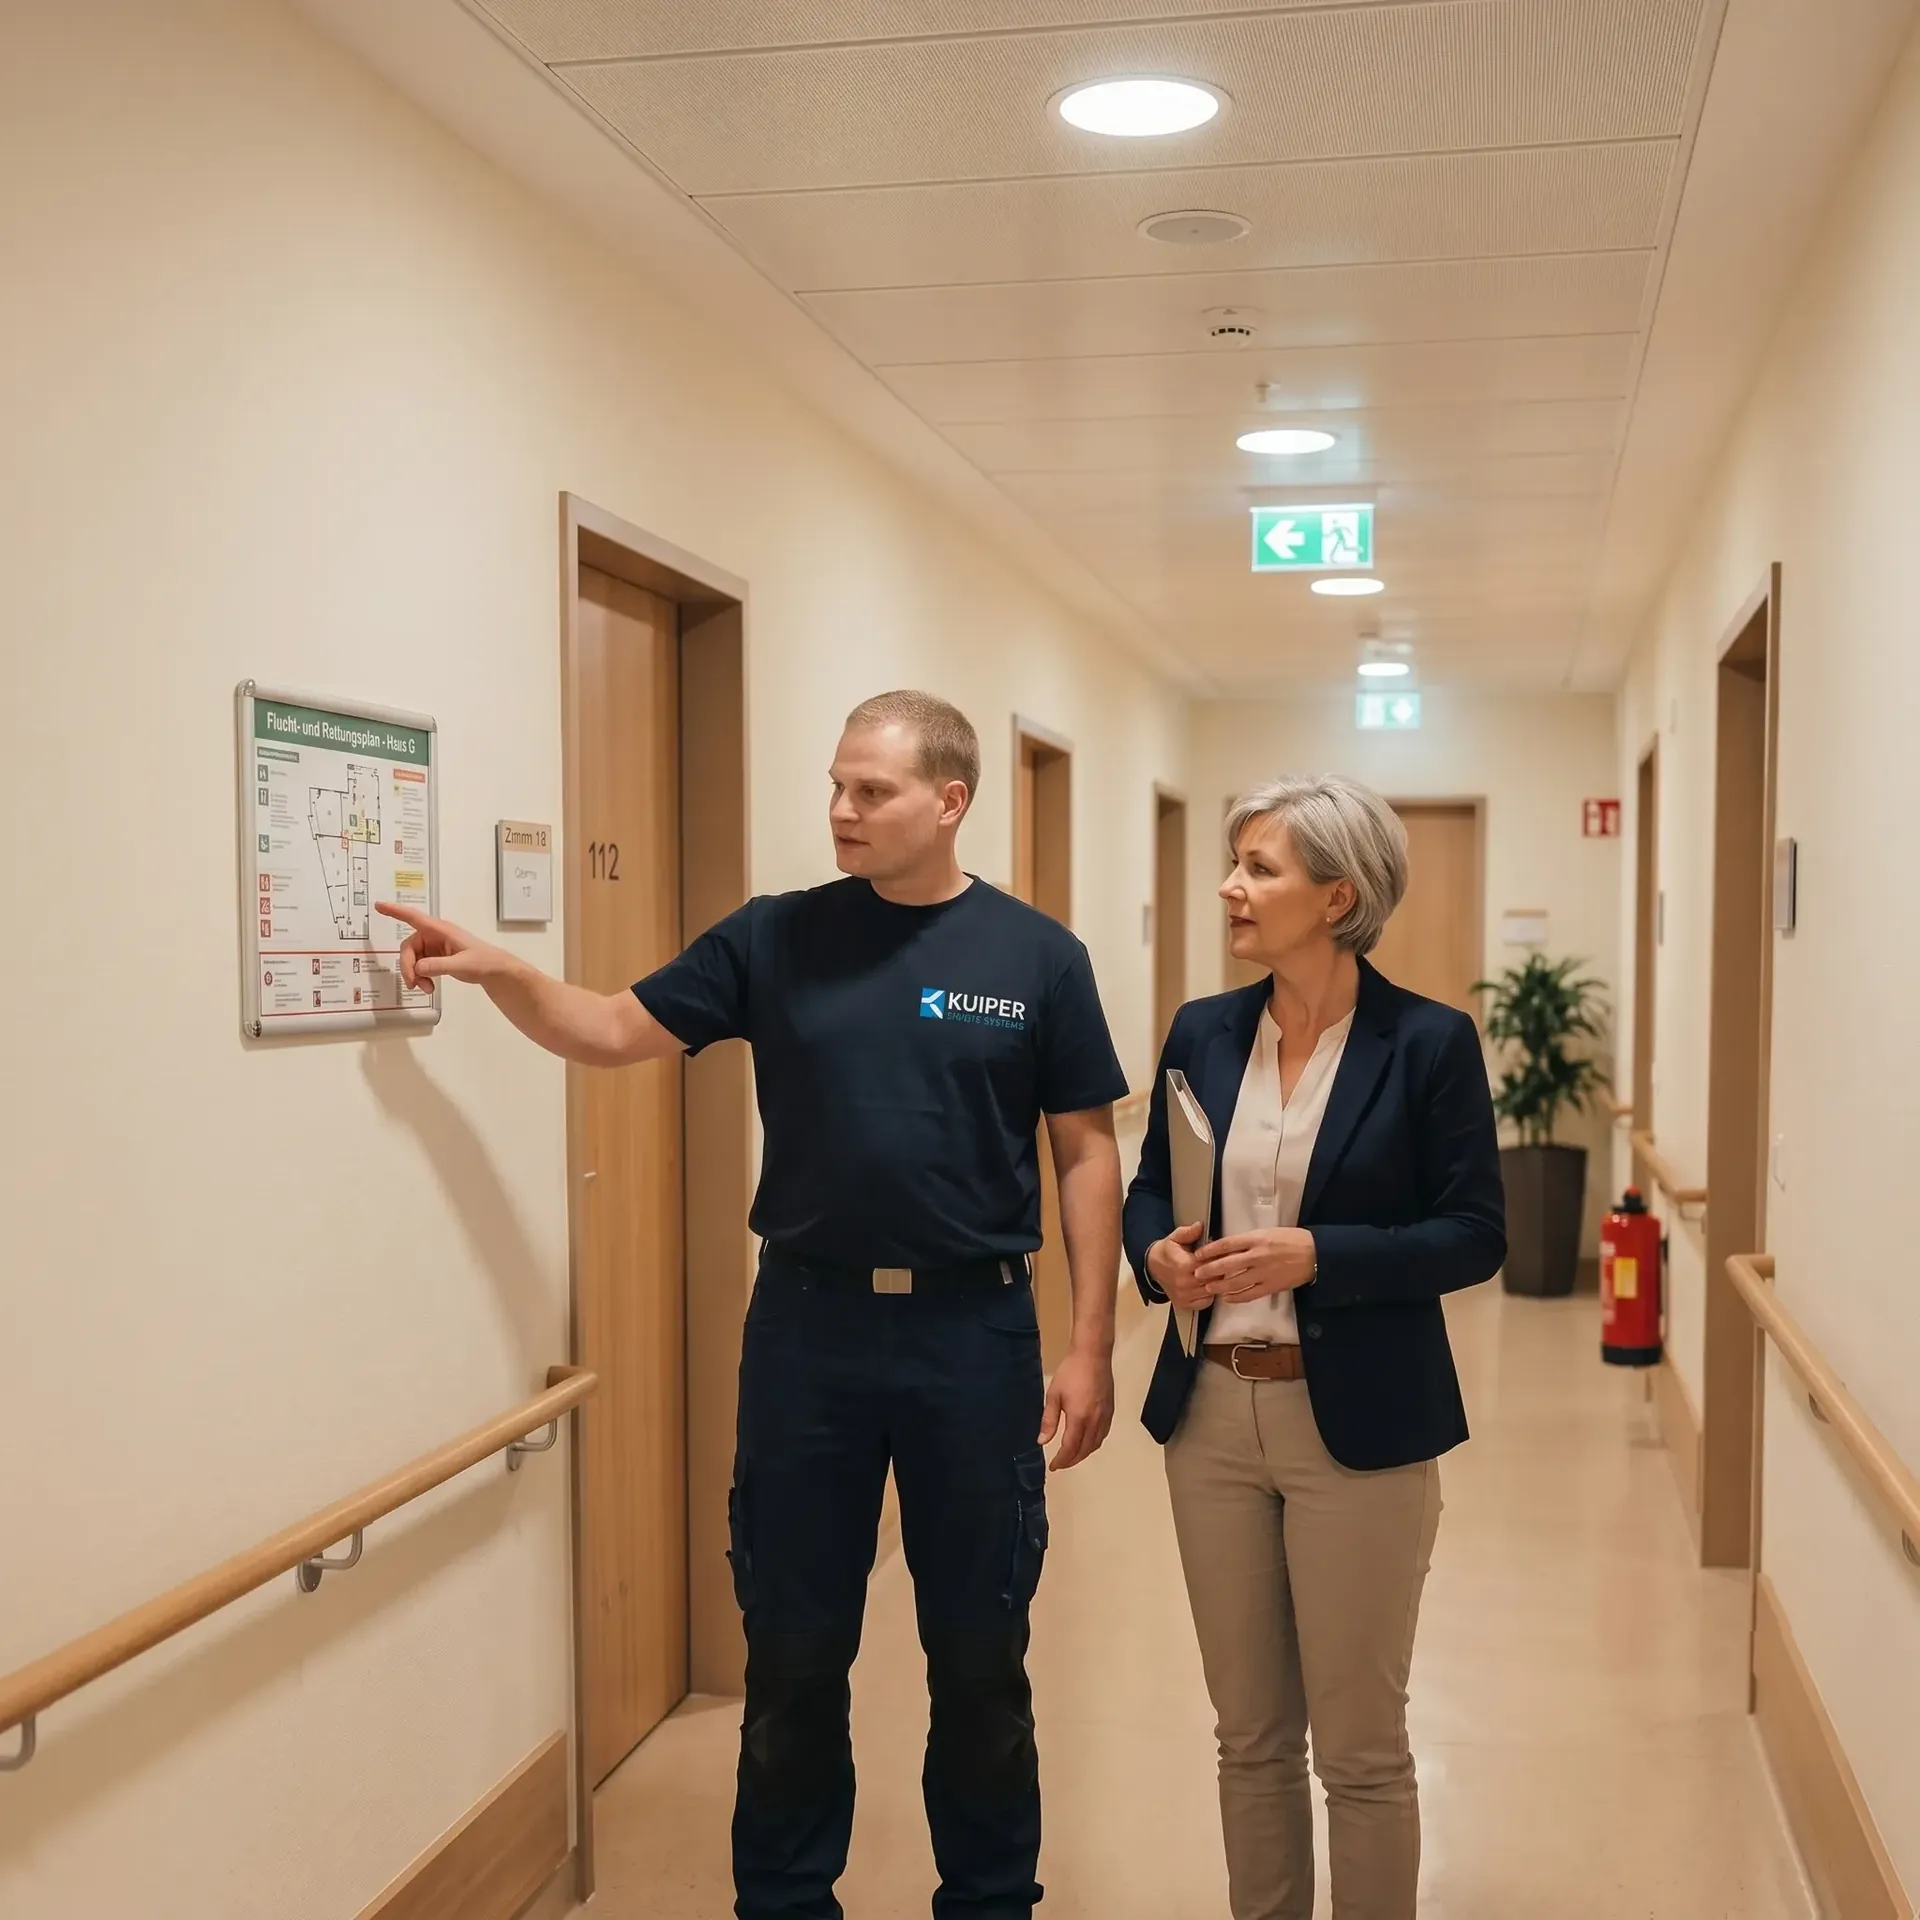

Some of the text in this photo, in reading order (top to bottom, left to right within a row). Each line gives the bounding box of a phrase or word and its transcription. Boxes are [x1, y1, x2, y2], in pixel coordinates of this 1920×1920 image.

[267, 711, 300, 734] Flucht-
[302, 721, 320, 737] und
[322, 721, 380, 749] Rettungsplan
[408, 738, 416, 754] G
[588, 841, 620, 881] 112
[948, 992, 1026, 1021] KUIPER
[983, 1016, 1025, 1031] SYSTEMS
